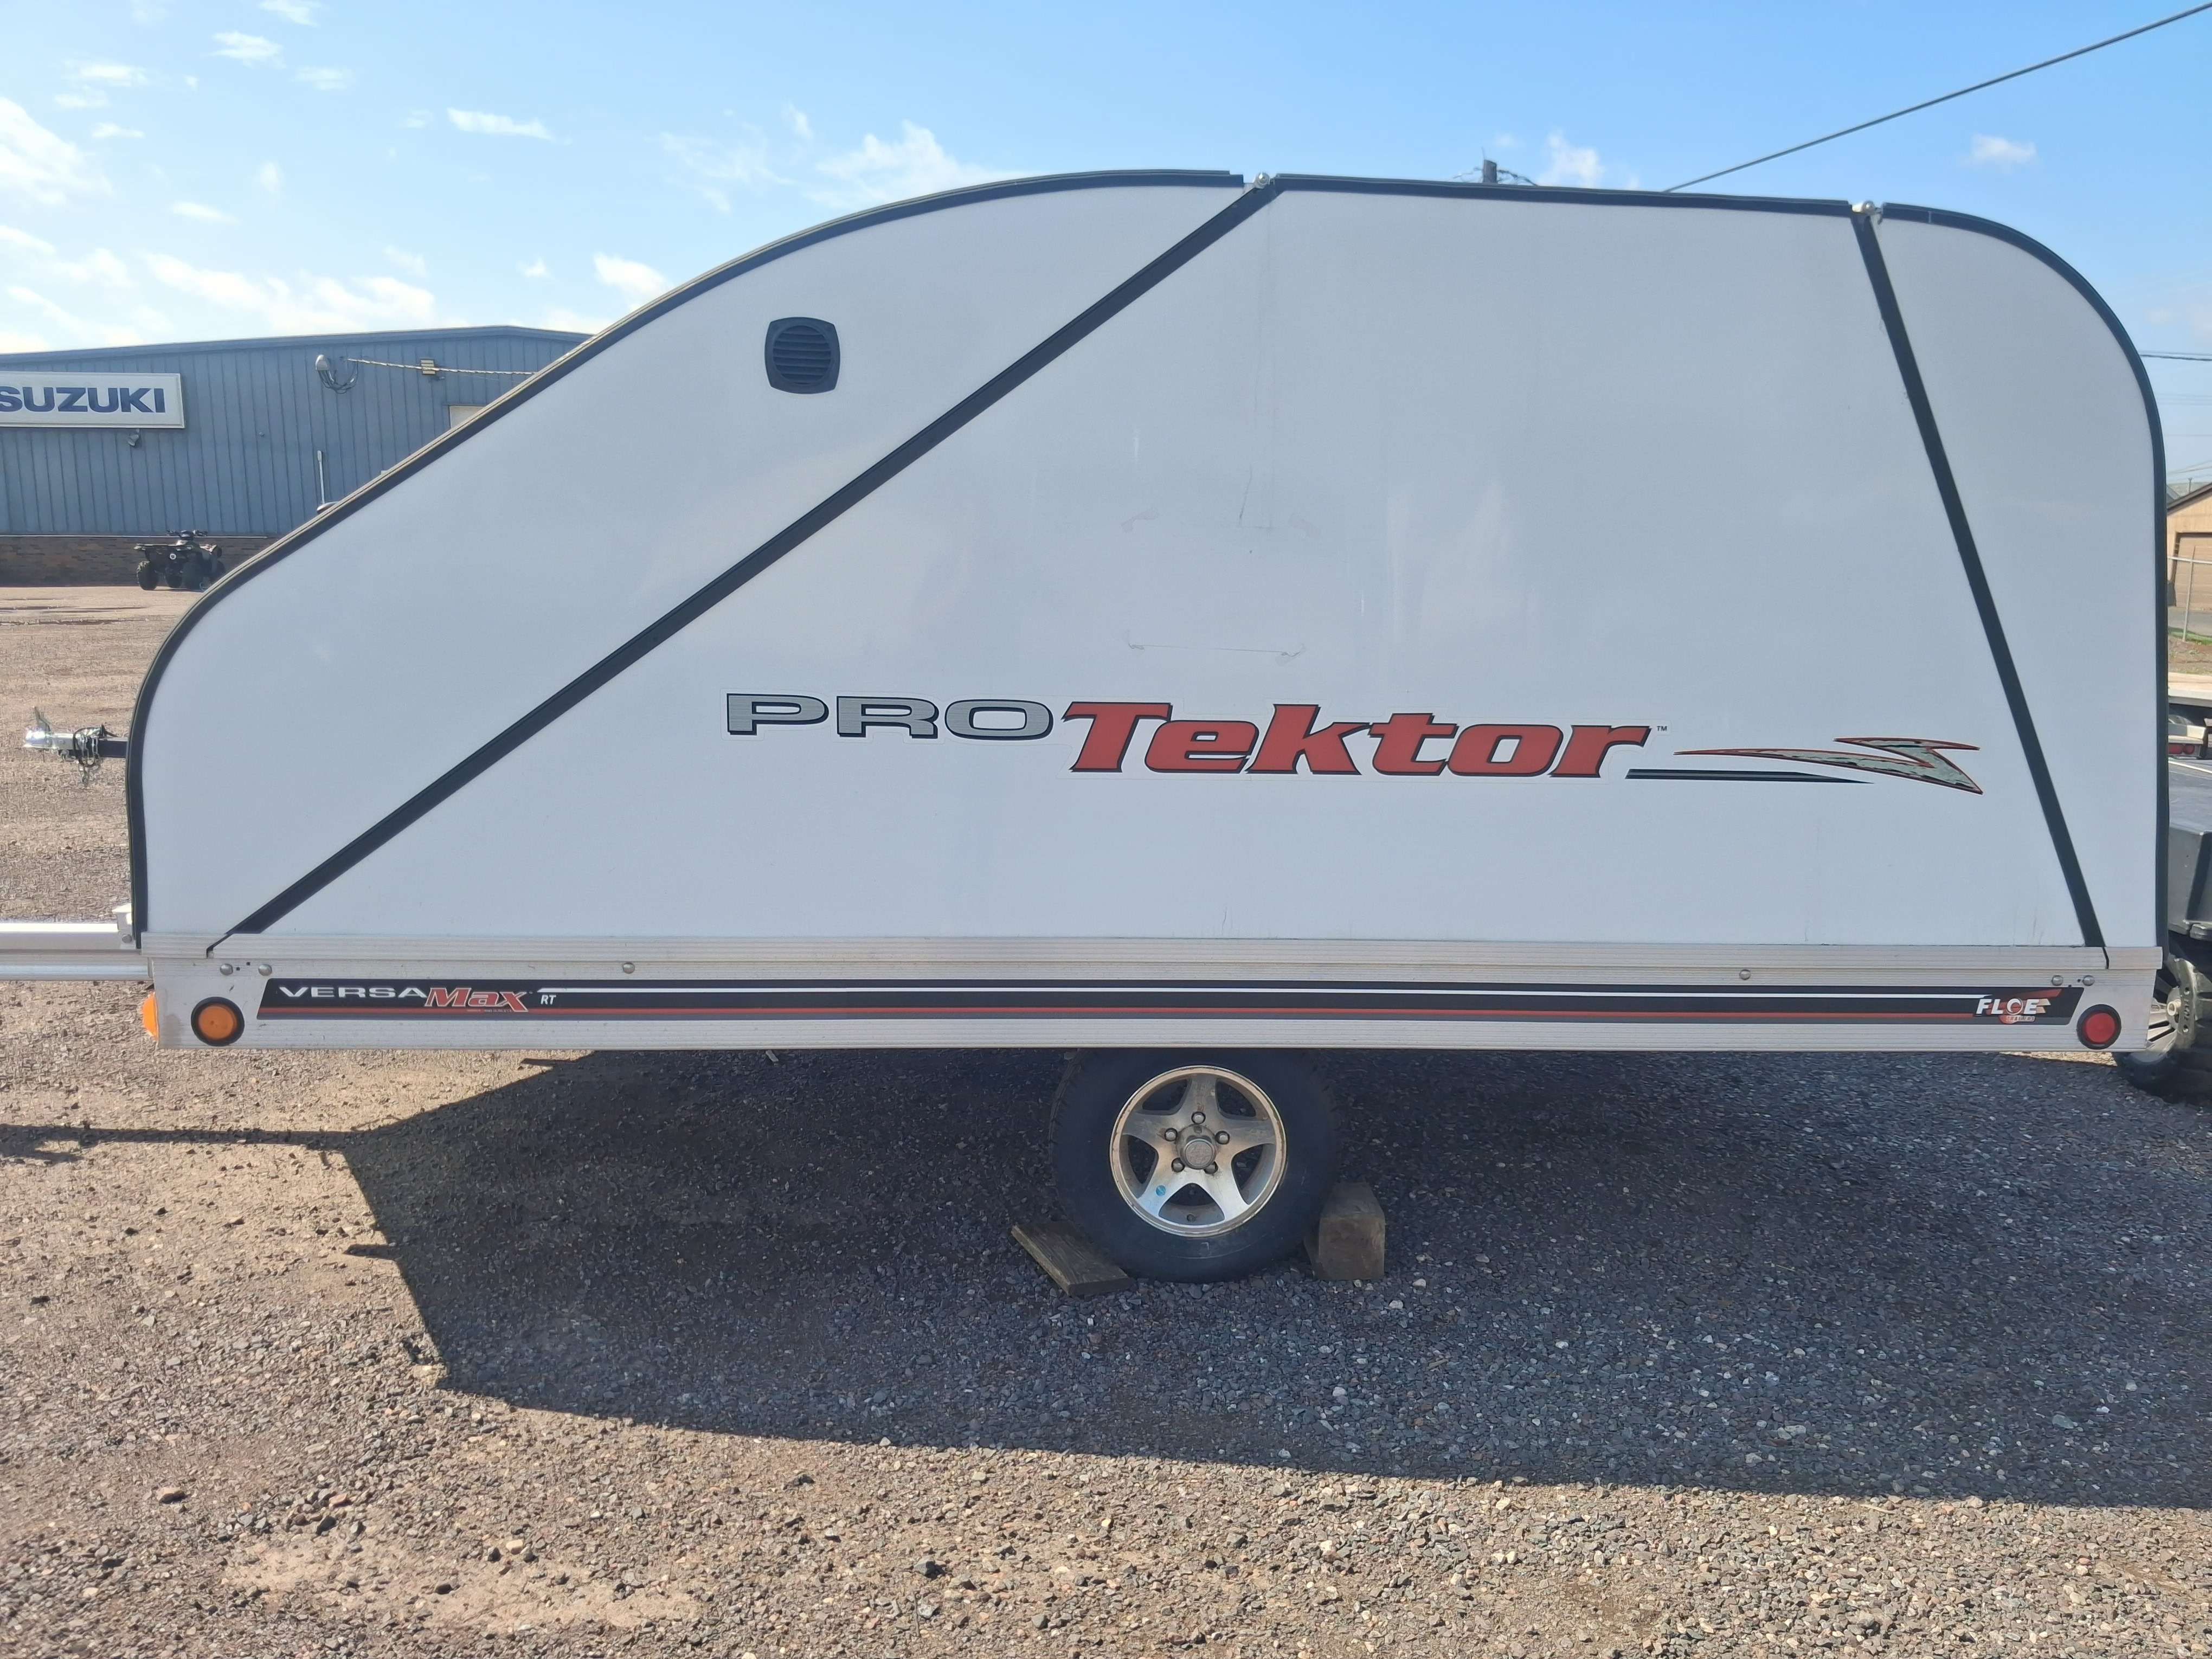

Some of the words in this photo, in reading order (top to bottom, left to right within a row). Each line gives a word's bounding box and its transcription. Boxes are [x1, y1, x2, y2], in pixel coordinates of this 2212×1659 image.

[0, 386, 166, 413] SUZUKI
[541, 995, 556, 1005] RT
[1976, 998, 2039, 1015] FLOE
